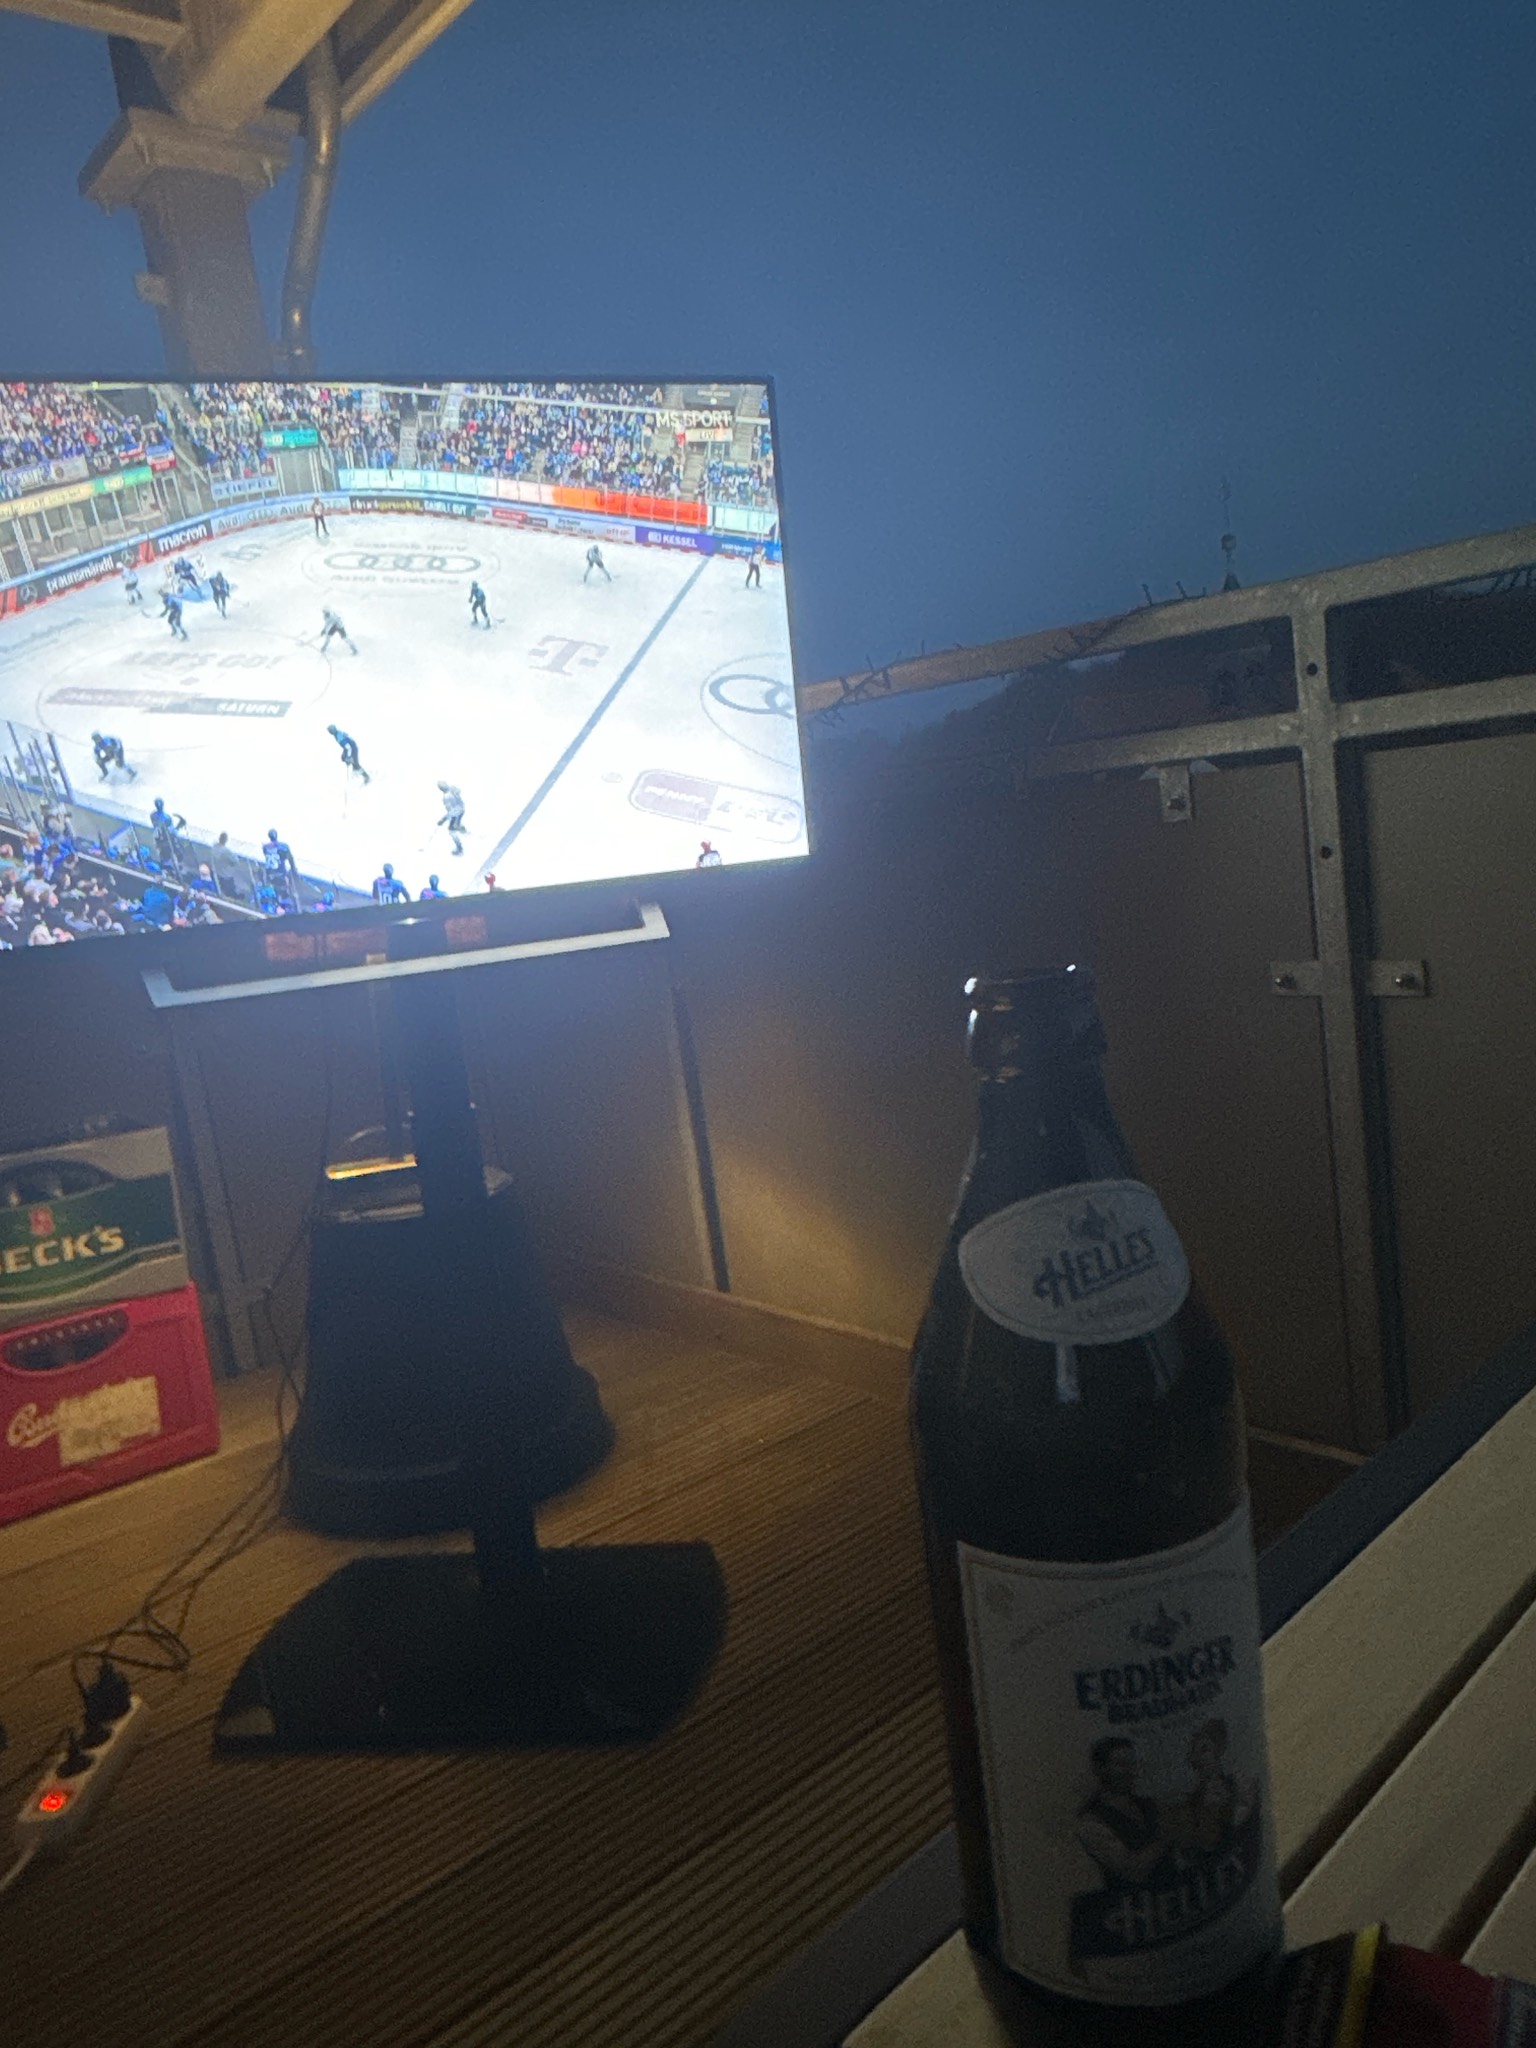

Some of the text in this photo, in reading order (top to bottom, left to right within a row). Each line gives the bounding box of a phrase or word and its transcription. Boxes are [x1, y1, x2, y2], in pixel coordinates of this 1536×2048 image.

[158, 523, 208, 553] macron
[662, 534, 698, 549] KESSEL
[217, 702, 280, 715] SATURN
[0, 1224, 126, 1275] ECK'S
[1032, 1228, 1158, 1307] HELLES
[1072, 1633, 1237, 1711] ERDINGER
